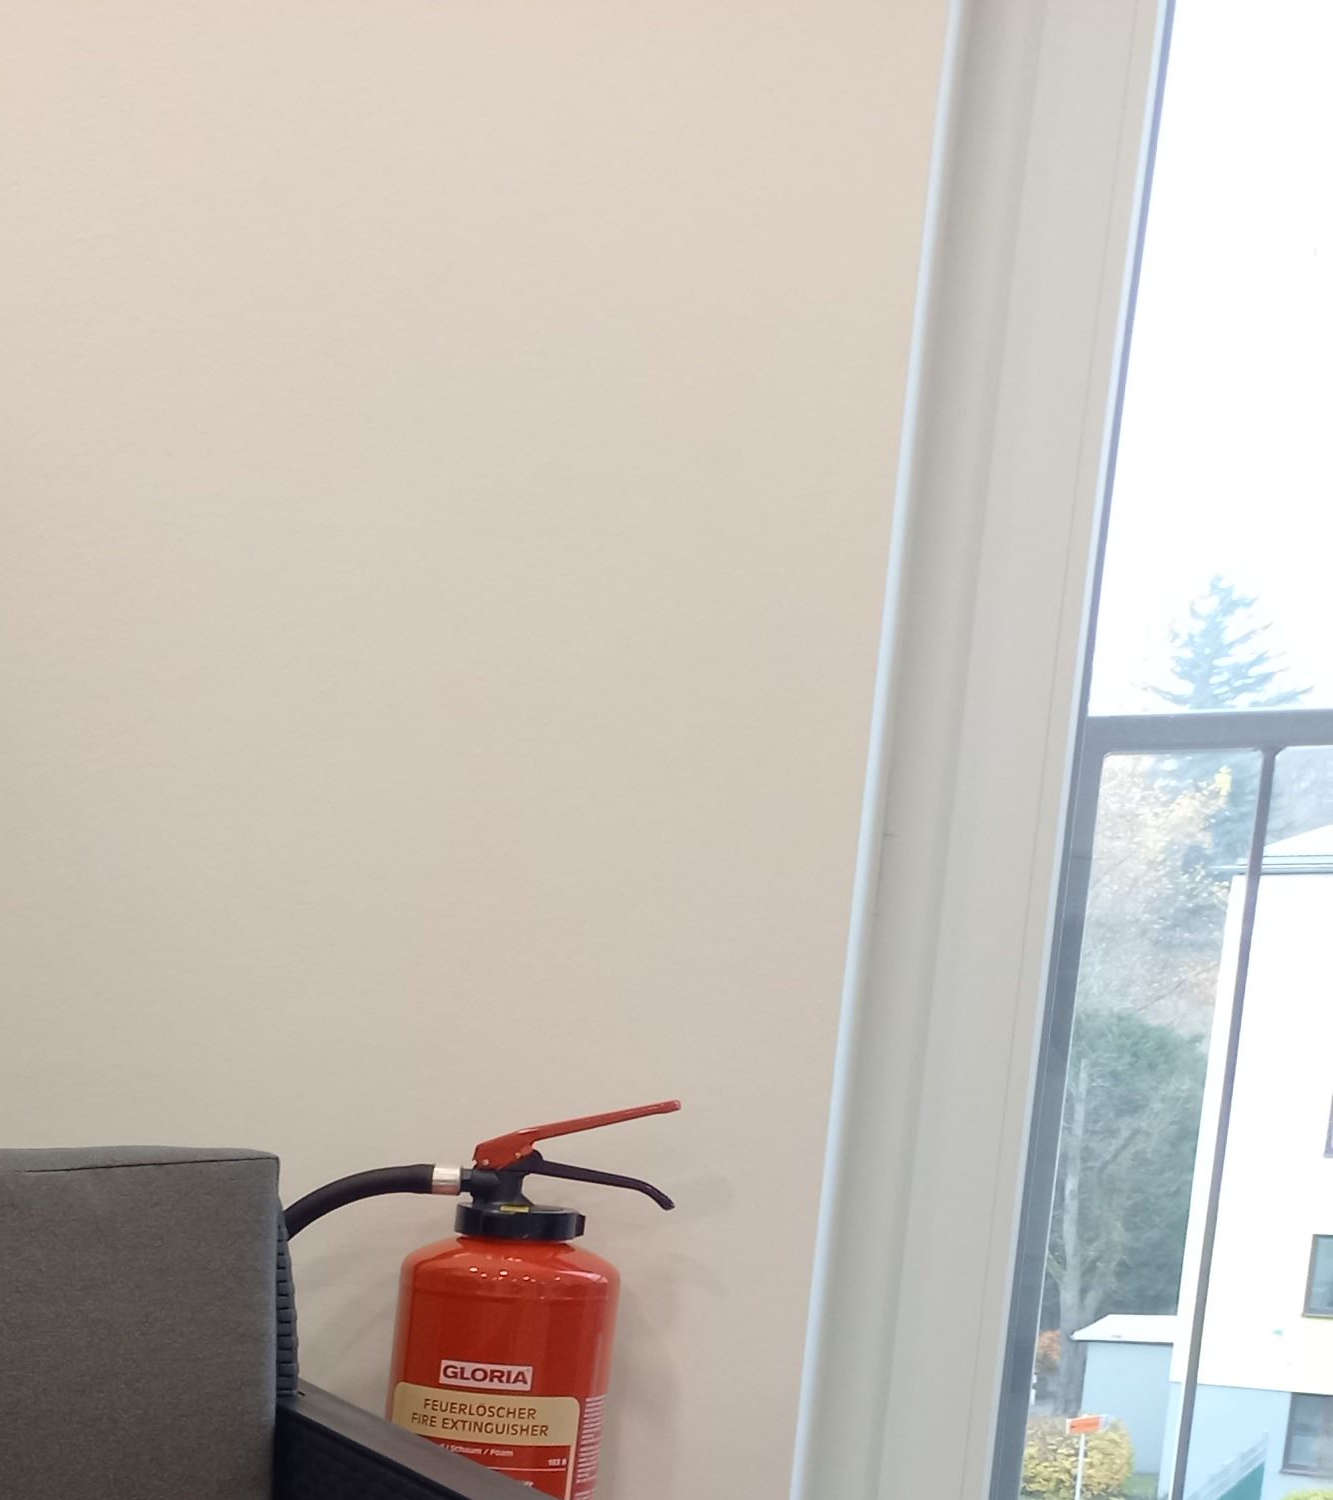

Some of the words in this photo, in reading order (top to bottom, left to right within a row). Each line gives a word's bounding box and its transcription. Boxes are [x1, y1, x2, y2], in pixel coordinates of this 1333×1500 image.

[442, 1364, 528, 1385] GLORIA
[423, 1398, 537, 1420] FEUERLÖSCHER
[411, 1412, 437, 1428] FIRE
[441, 1417, 549, 1436] EXTINGUISHER
